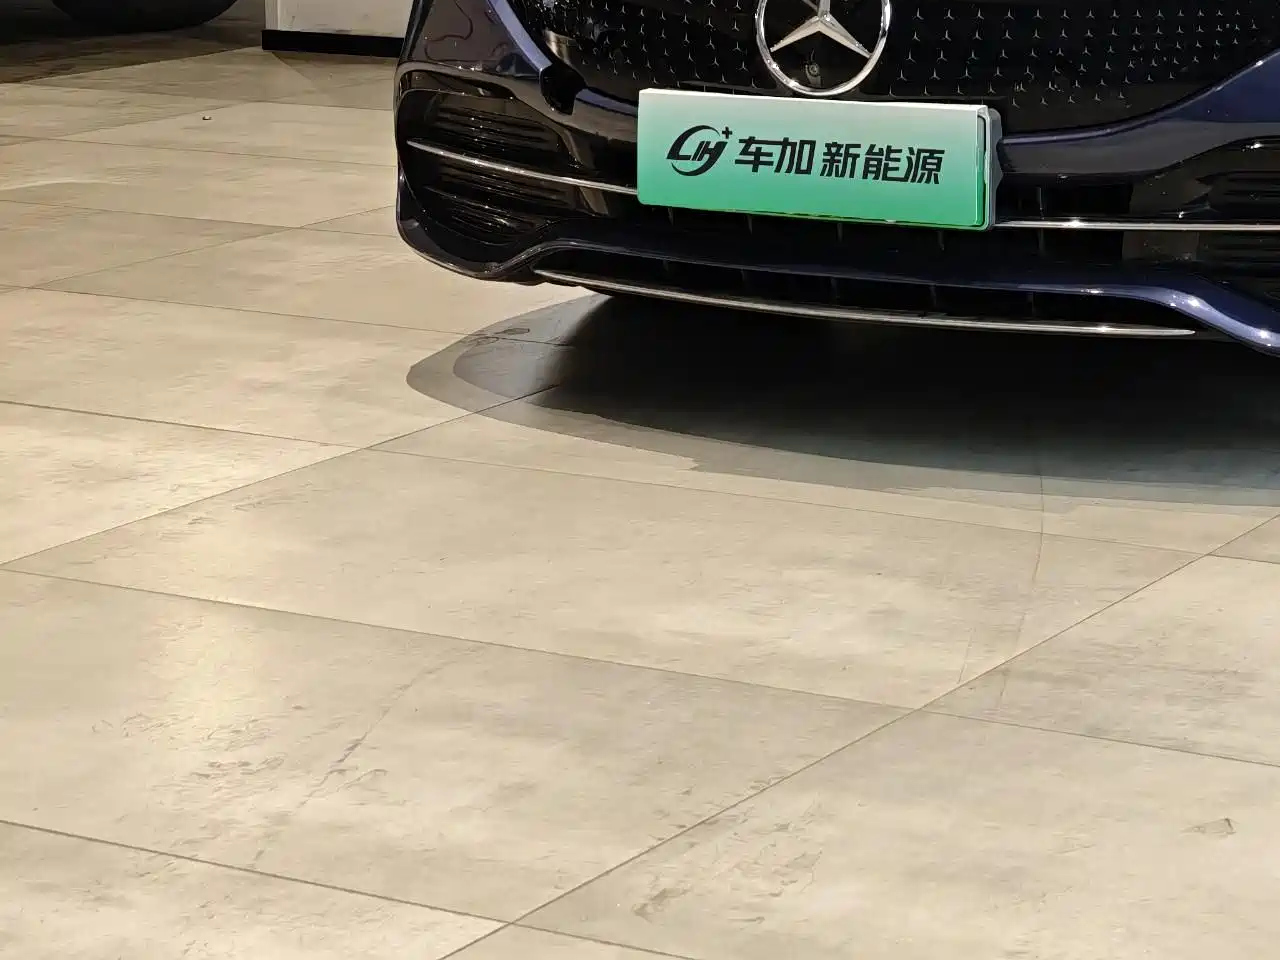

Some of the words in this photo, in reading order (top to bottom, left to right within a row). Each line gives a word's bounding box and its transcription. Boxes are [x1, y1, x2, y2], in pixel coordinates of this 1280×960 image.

[734, 136, 945, 185] 车加新能源
